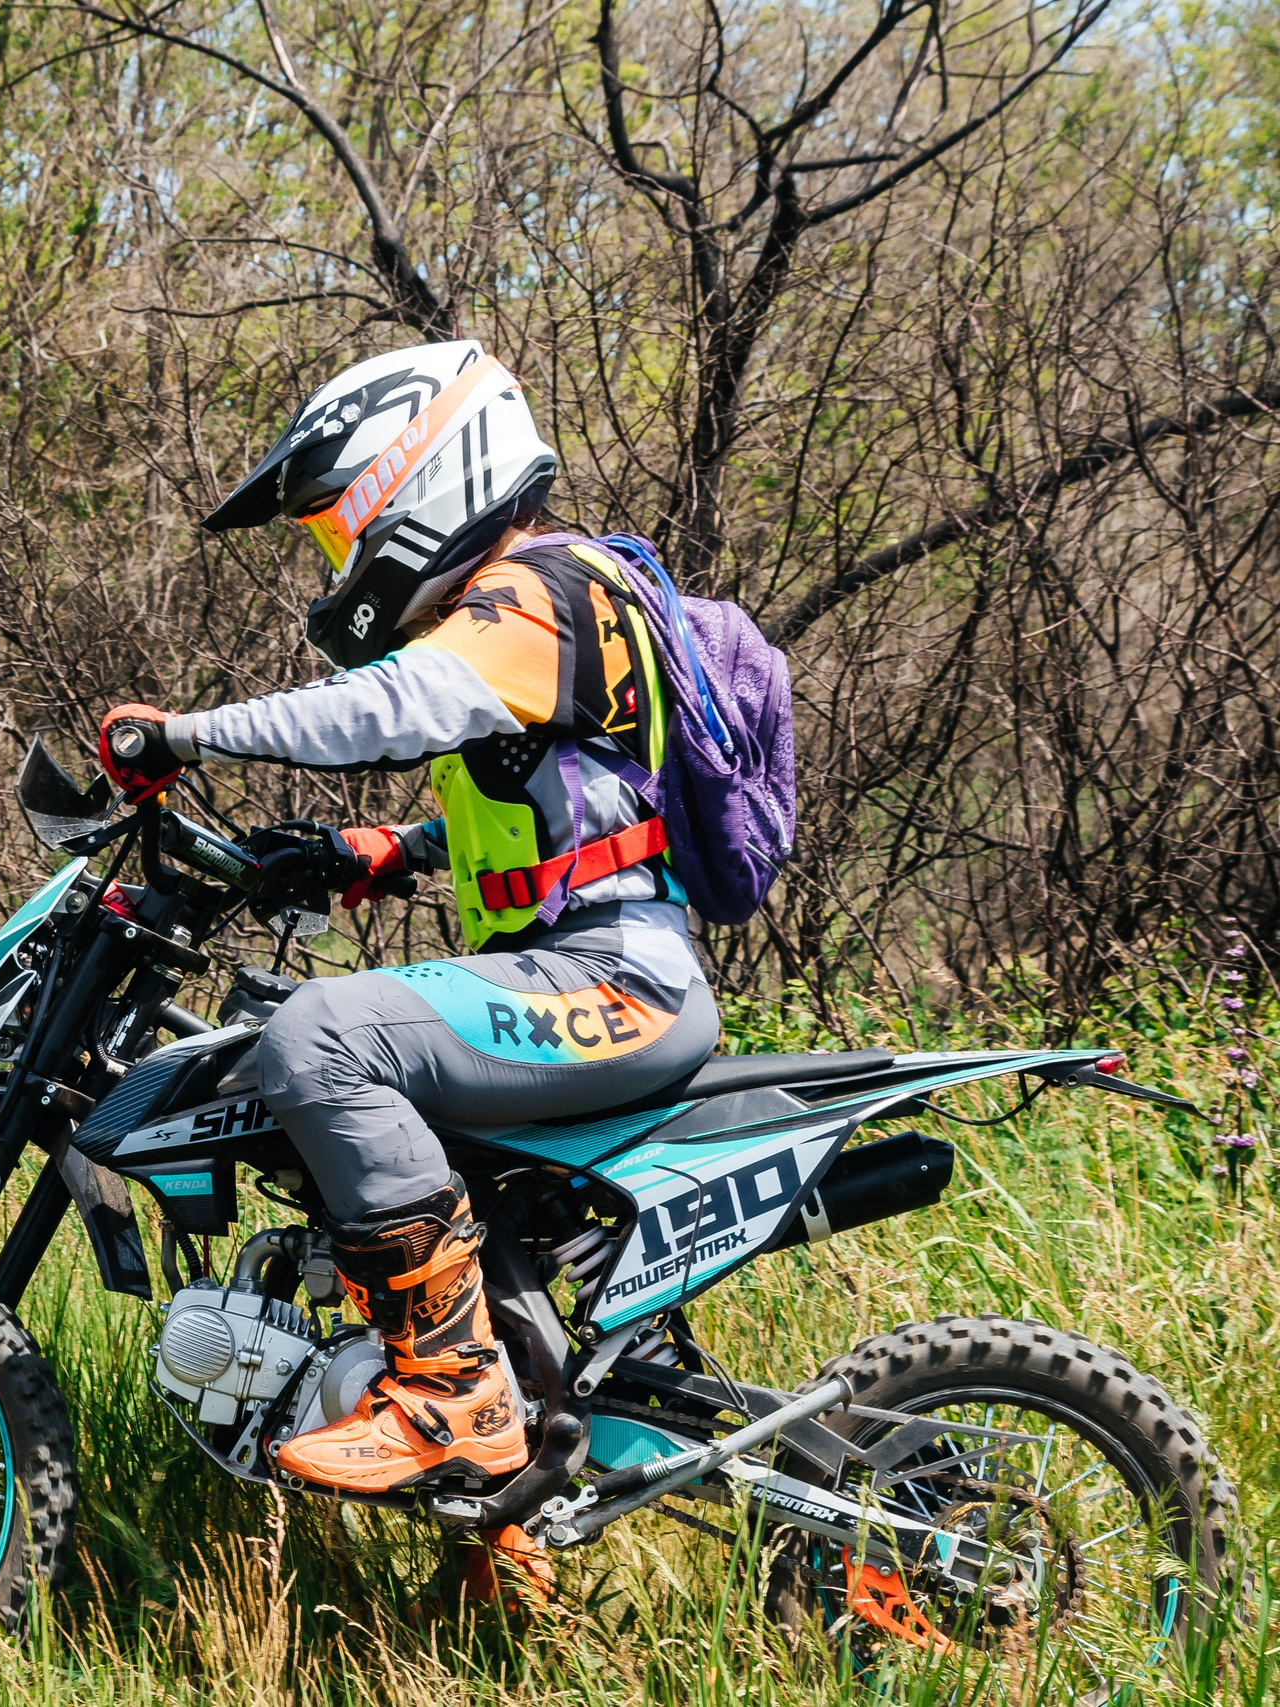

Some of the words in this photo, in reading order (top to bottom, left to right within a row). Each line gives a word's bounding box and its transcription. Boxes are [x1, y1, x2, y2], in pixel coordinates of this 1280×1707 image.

[191, 836, 246, 880] SHARMAX
[602, 1146, 666, 1175] DUNLOP
[164, 1179, 208, 1191] KENDA
[638, 1147, 802, 1267] 190
[605, 1227, 748, 1305] POWERMAX
[339, 1444, 394, 1459] TE6
